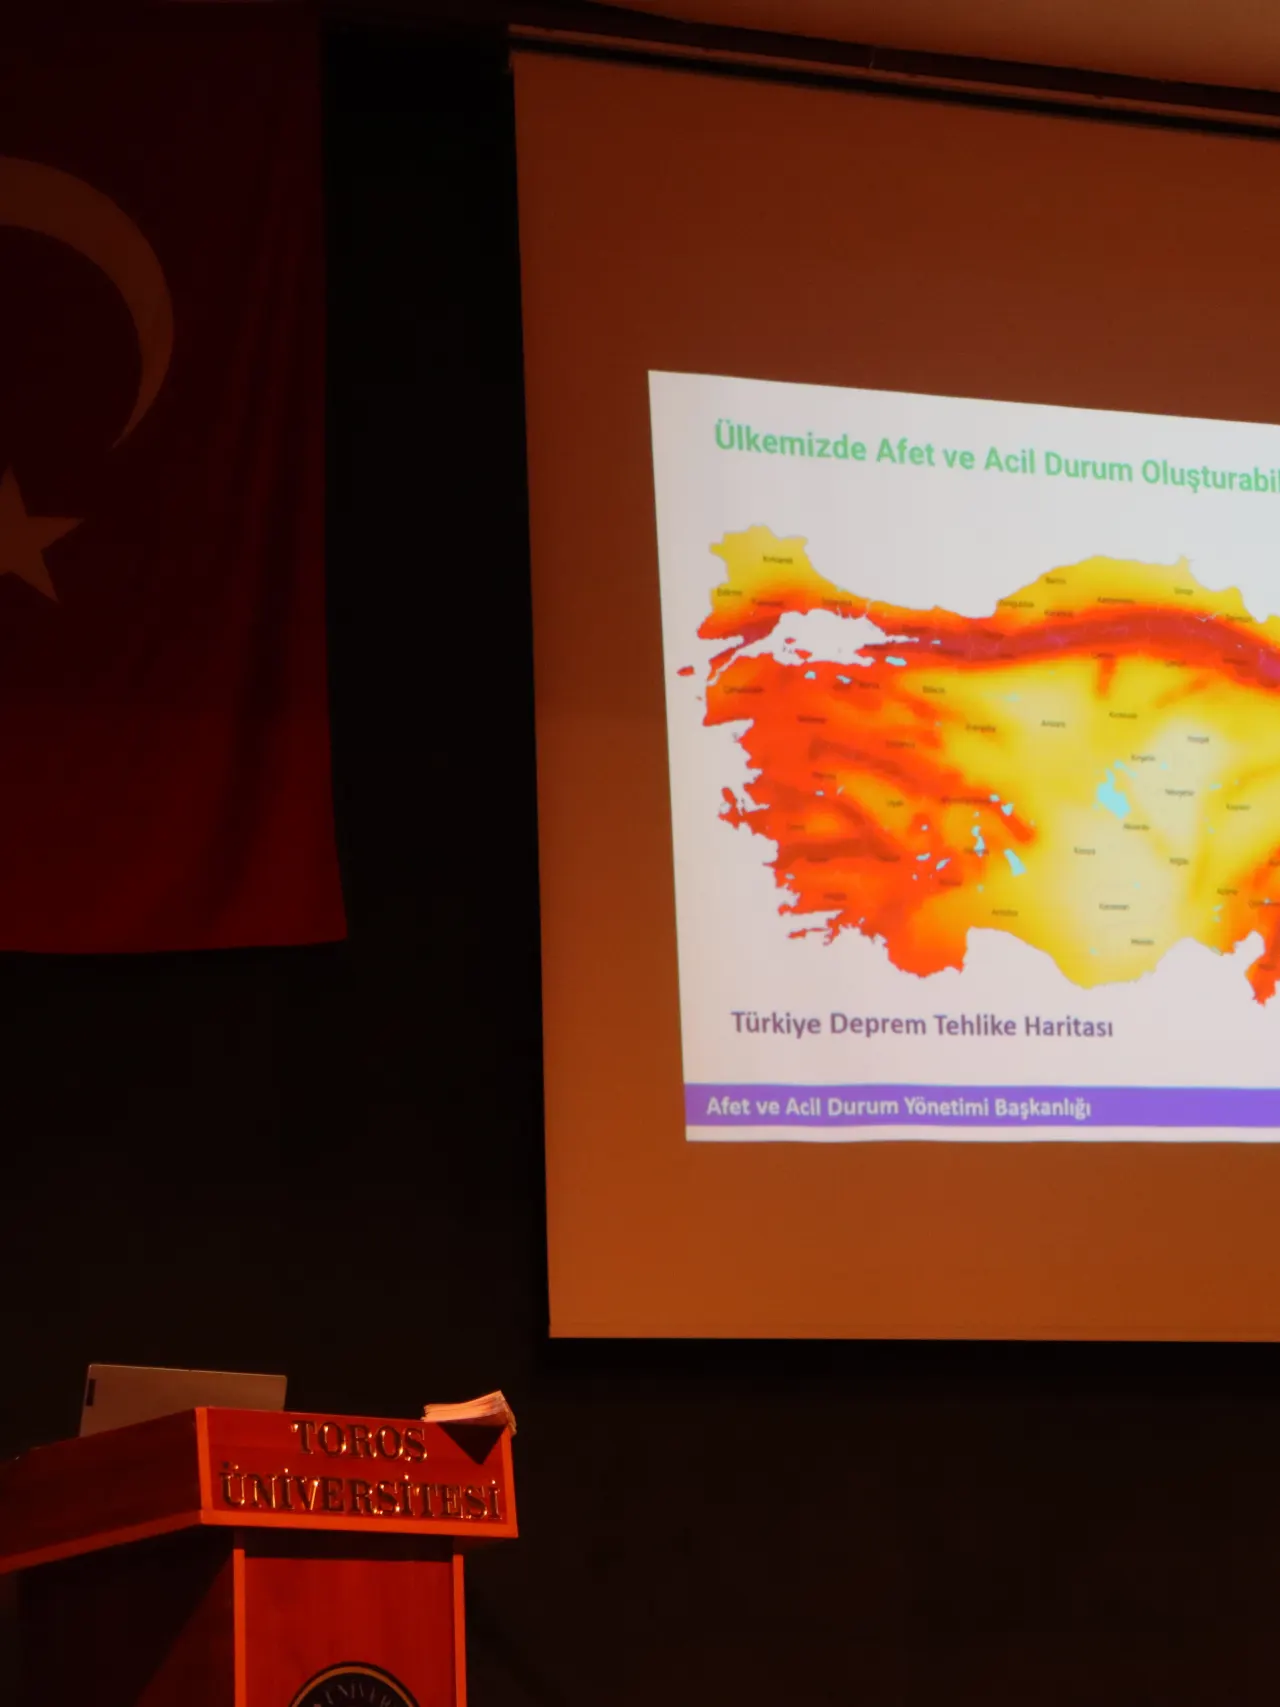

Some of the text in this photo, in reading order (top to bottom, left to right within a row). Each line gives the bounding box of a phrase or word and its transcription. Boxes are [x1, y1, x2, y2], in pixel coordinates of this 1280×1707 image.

[714, 418, 867, 462] Ülkemizde
[876, 437, 936, 467] Afet
[943, 448, 976, 470] ve
[984, 446, 1036, 475] Acil
[1044, 451, 1133, 482] Durum
[731, 1010, 1113, 1040] Türkiye Deprem Tehlike Haritası
[706, 1095, 1092, 1121] Afet ve Acil Durum Yönetimi Başkanlığı
[291, 1420, 428, 1462] TOROS
[219, 1461, 503, 1520] ÜNİVERSİTESİ
